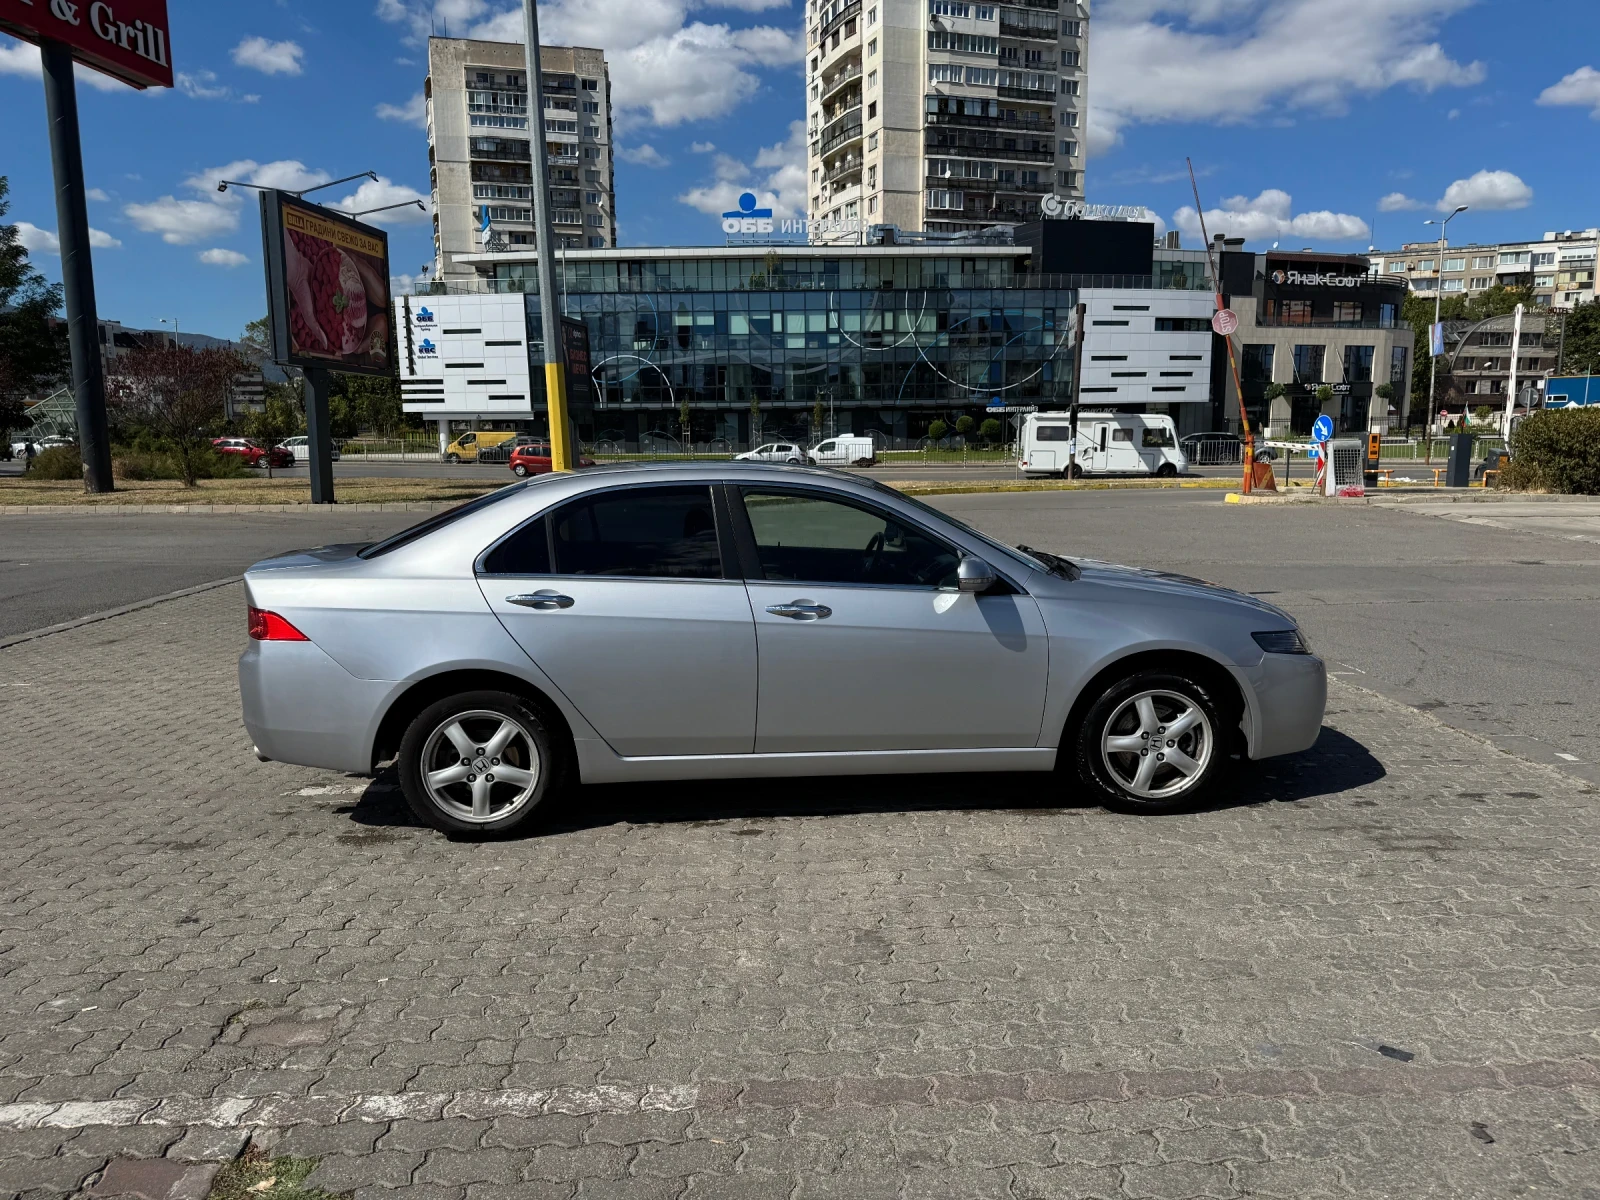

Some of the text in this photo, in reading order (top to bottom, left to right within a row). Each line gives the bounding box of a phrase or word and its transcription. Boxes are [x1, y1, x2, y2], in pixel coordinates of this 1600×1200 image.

[90, 1, 168, 68] Grill
[305, 219, 379, 253] ГРАДИНИ СВЕЖО ЗА ВАС
[722, 217, 774, 234] ОББ
[1218, 312, 1232, 333] STOP
